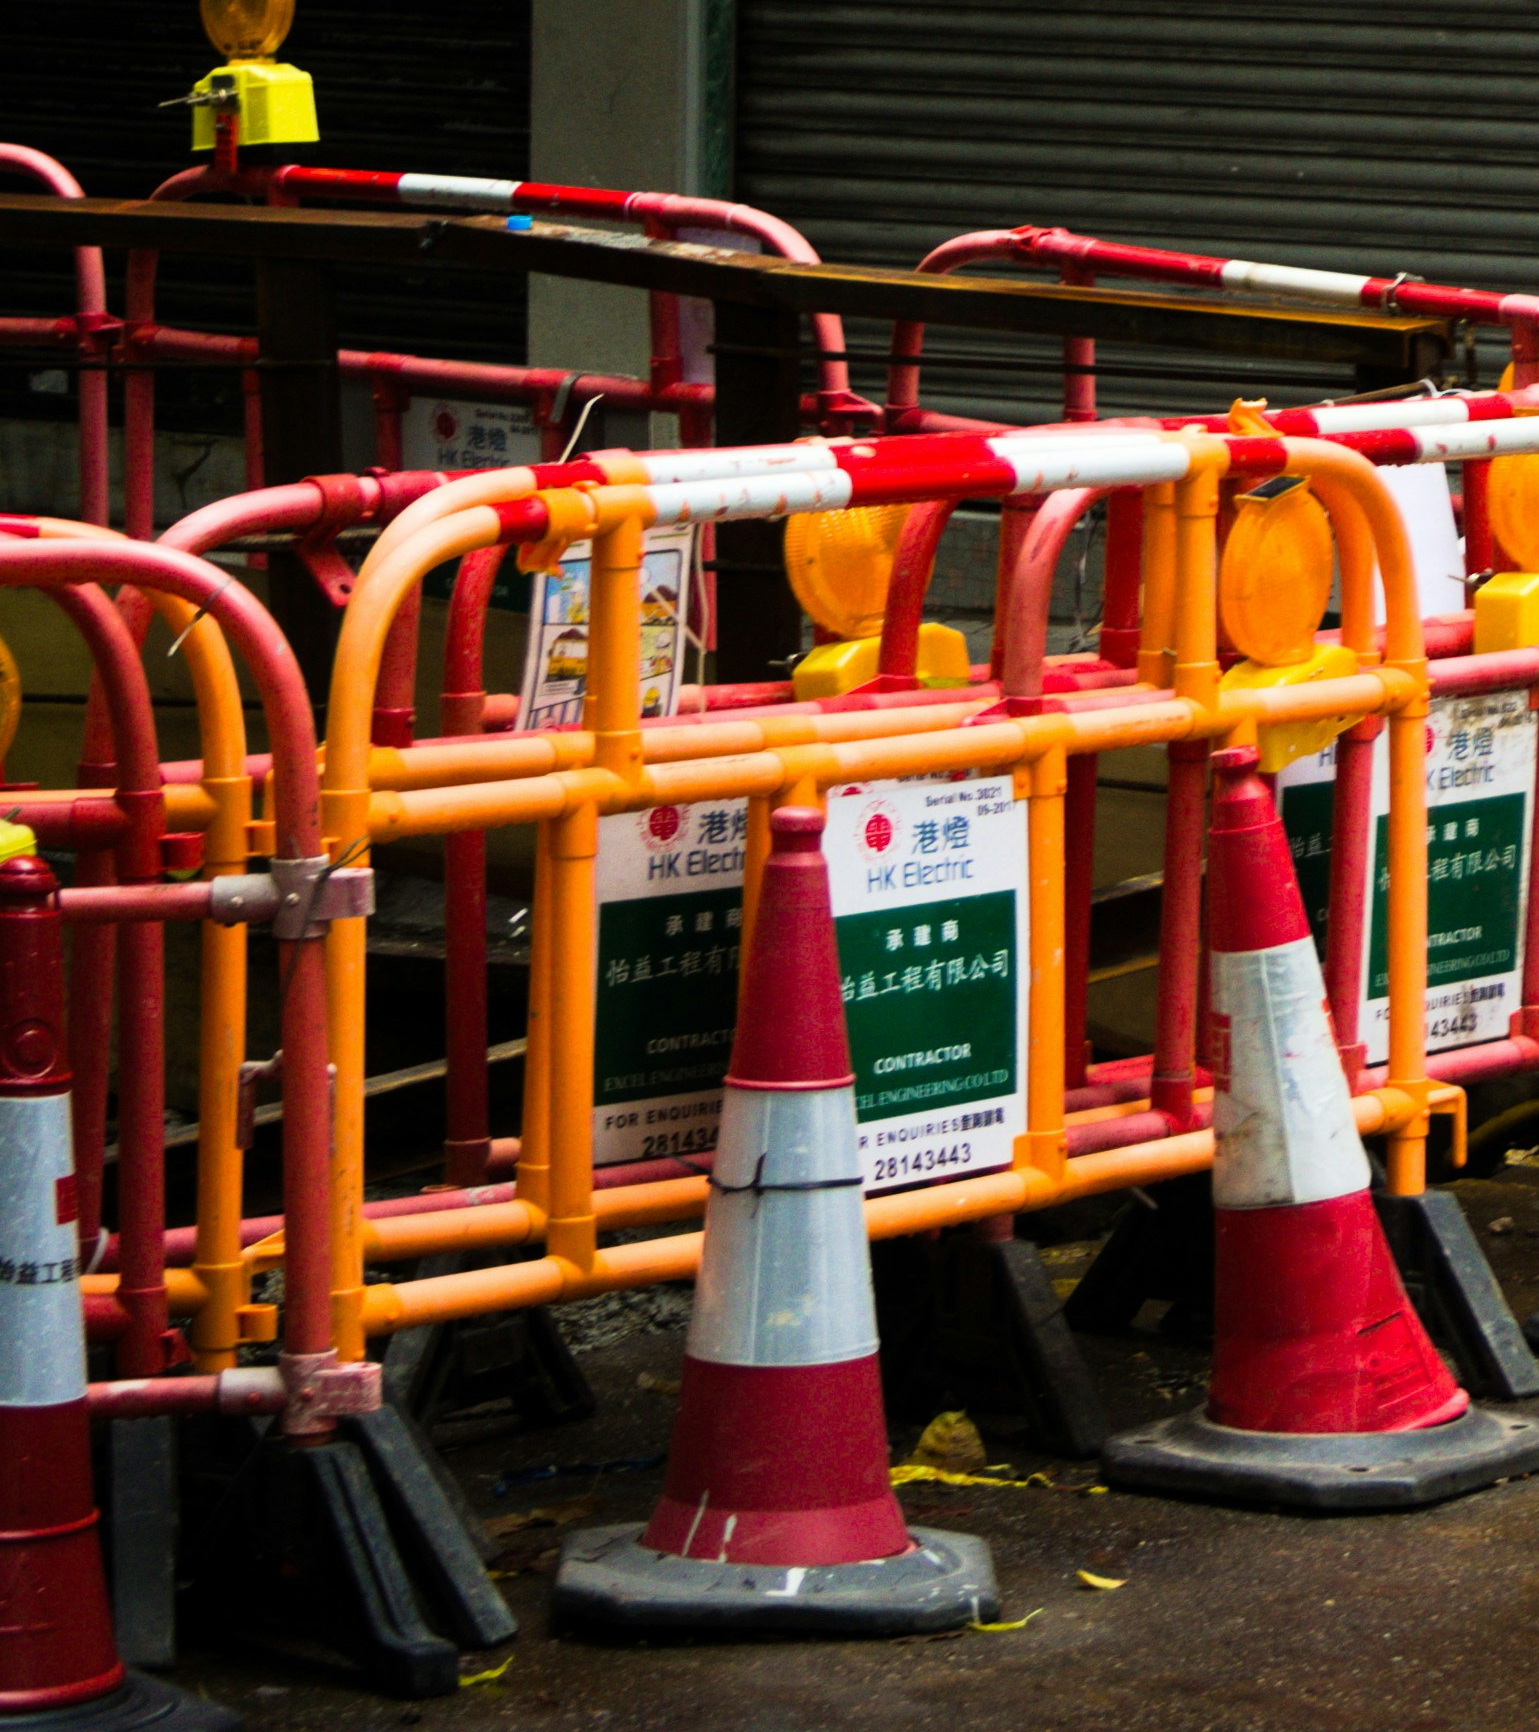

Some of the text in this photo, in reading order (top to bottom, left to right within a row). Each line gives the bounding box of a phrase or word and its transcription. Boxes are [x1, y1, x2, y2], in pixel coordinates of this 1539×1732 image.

[647, 852, 682, 881] HK
[866, 854, 974, 893] HK Electric
[885, 918, 959, 952] 承建商
[873, 1042, 972, 1075] CONTRACTOR
[605, 1112, 639, 1130] FOR
[873, 1142, 972, 1181] 28143443
